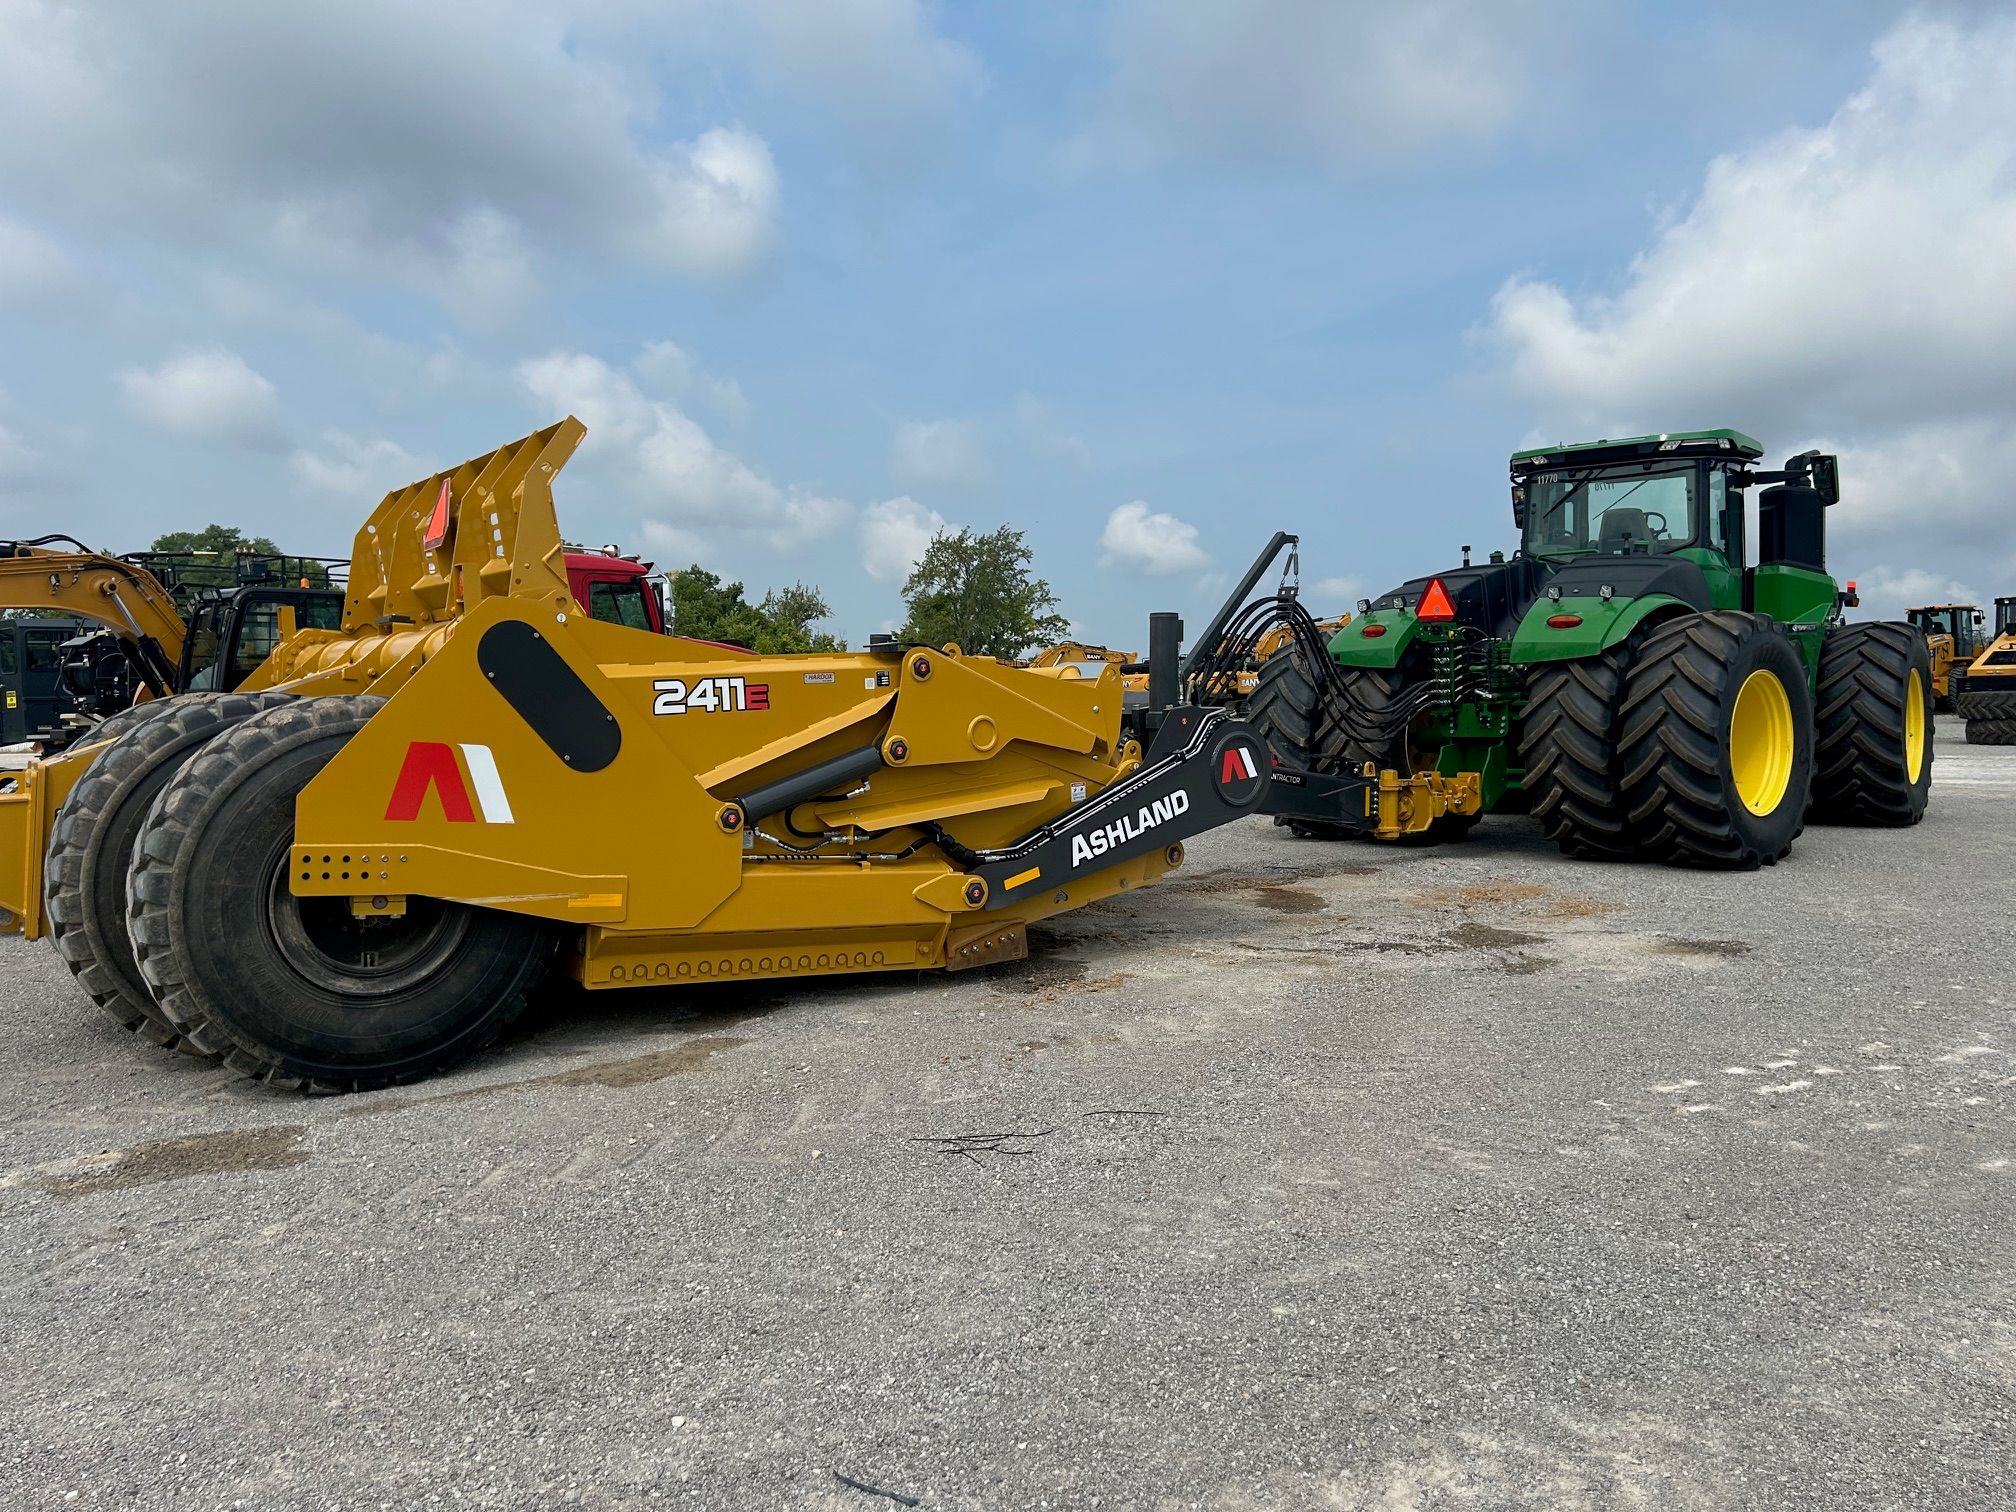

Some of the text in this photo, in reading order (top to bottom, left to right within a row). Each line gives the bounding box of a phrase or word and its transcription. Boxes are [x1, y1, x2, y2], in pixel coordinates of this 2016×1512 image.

[1537, 473, 1558, 485] 11770
[653, 677, 769, 716] 2411E
[1072, 789, 1189, 868] ASHLAND
